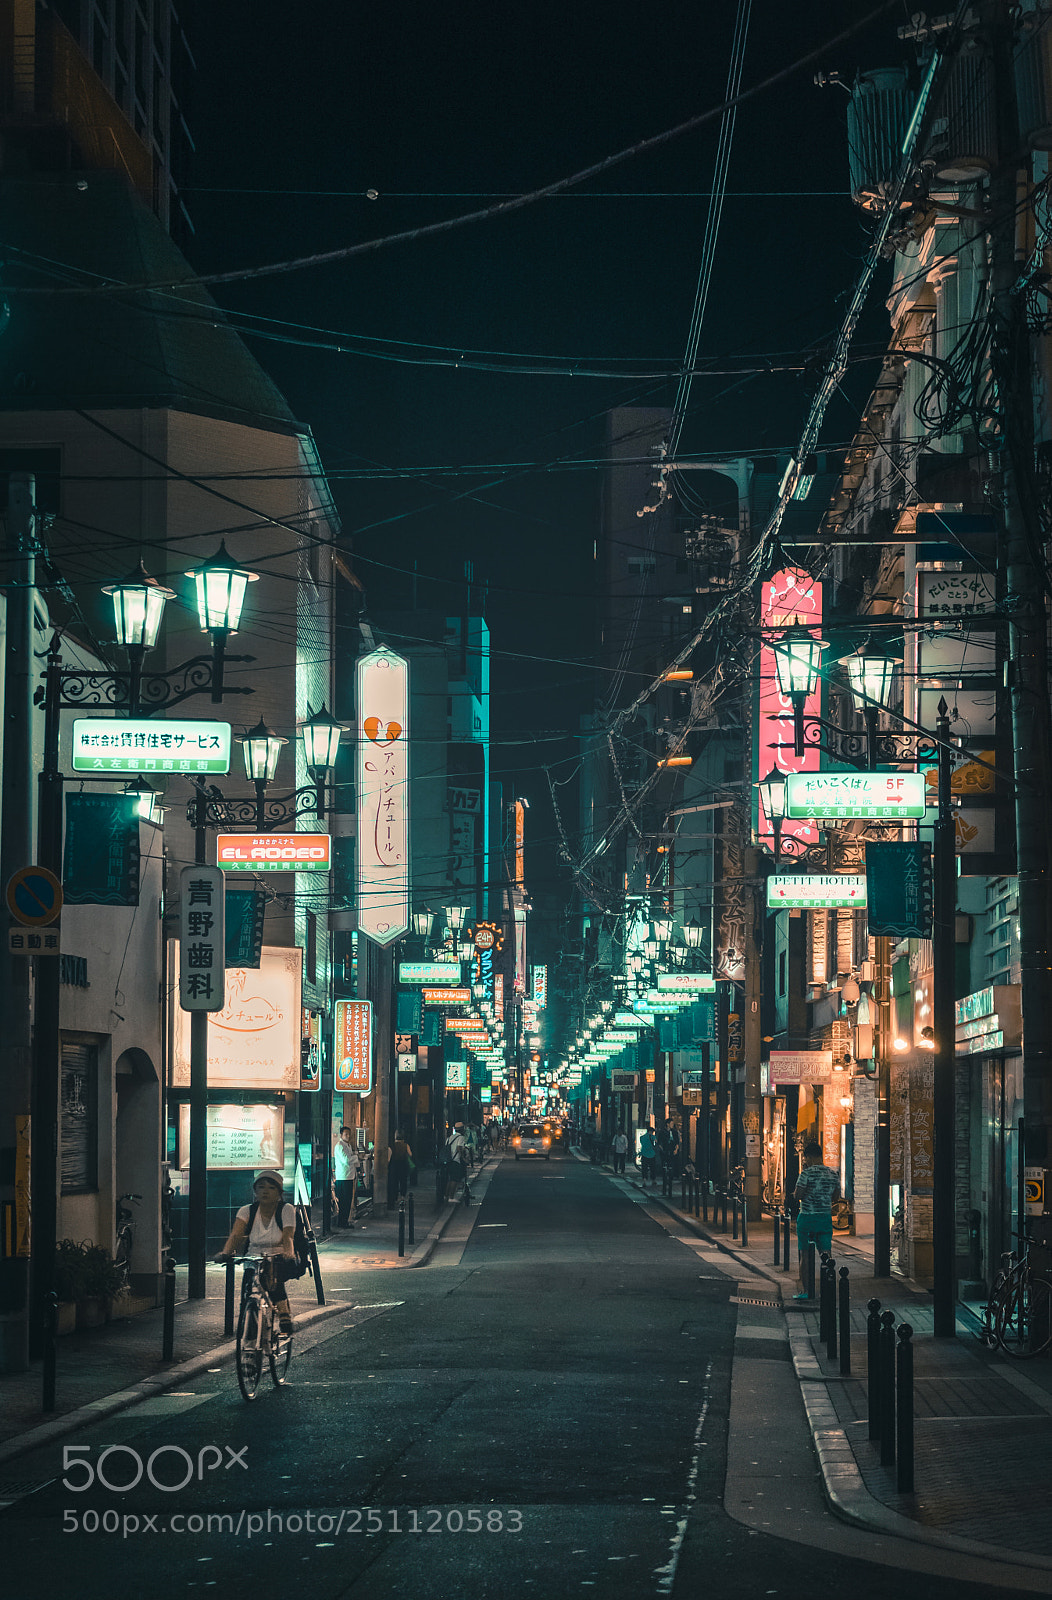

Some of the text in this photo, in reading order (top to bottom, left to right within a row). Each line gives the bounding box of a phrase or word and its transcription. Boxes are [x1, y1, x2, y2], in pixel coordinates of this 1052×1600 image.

[947, 590, 969, 599] ごとう
[81, 732, 221, 750] 株式会社賃貸住宅サービス
[93, 758, 209, 771] 久左衛門商店街
[886, 778, 904, 790] 5F
[383, 752, 396, 853] アバンチュール
[807, 807, 908, 817] 久左衛門商店街
[107, 807, 125, 891] 久左衛門町
[252, 838, 295, 846] おおさかミナミ
[222, 847, 326, 859] EL RODEO
[231, 861, 317, 871] 久左衛門商店街
[774, 876, 864, 886] PETIT HOTEL
[904, 852, 919, 926] 久左衛門町
[781, 899, 854, 907] 久左衛門商店街
[238, 900, 252, 959] 久左衛門町
[10, 934, 58, 949] 自動車
[186, 878, 215, 1000] 青野歯科
[476, 932, 493, 942] 24H
[59, 954, 91, 988] ENTAL
[535, 972, 544, 999] カラオケ
[690, 1055, 714, 1063] NES
[825, 1111, 839, 1153] 女子会
[912, 1107, 932, 1168] 女子会
